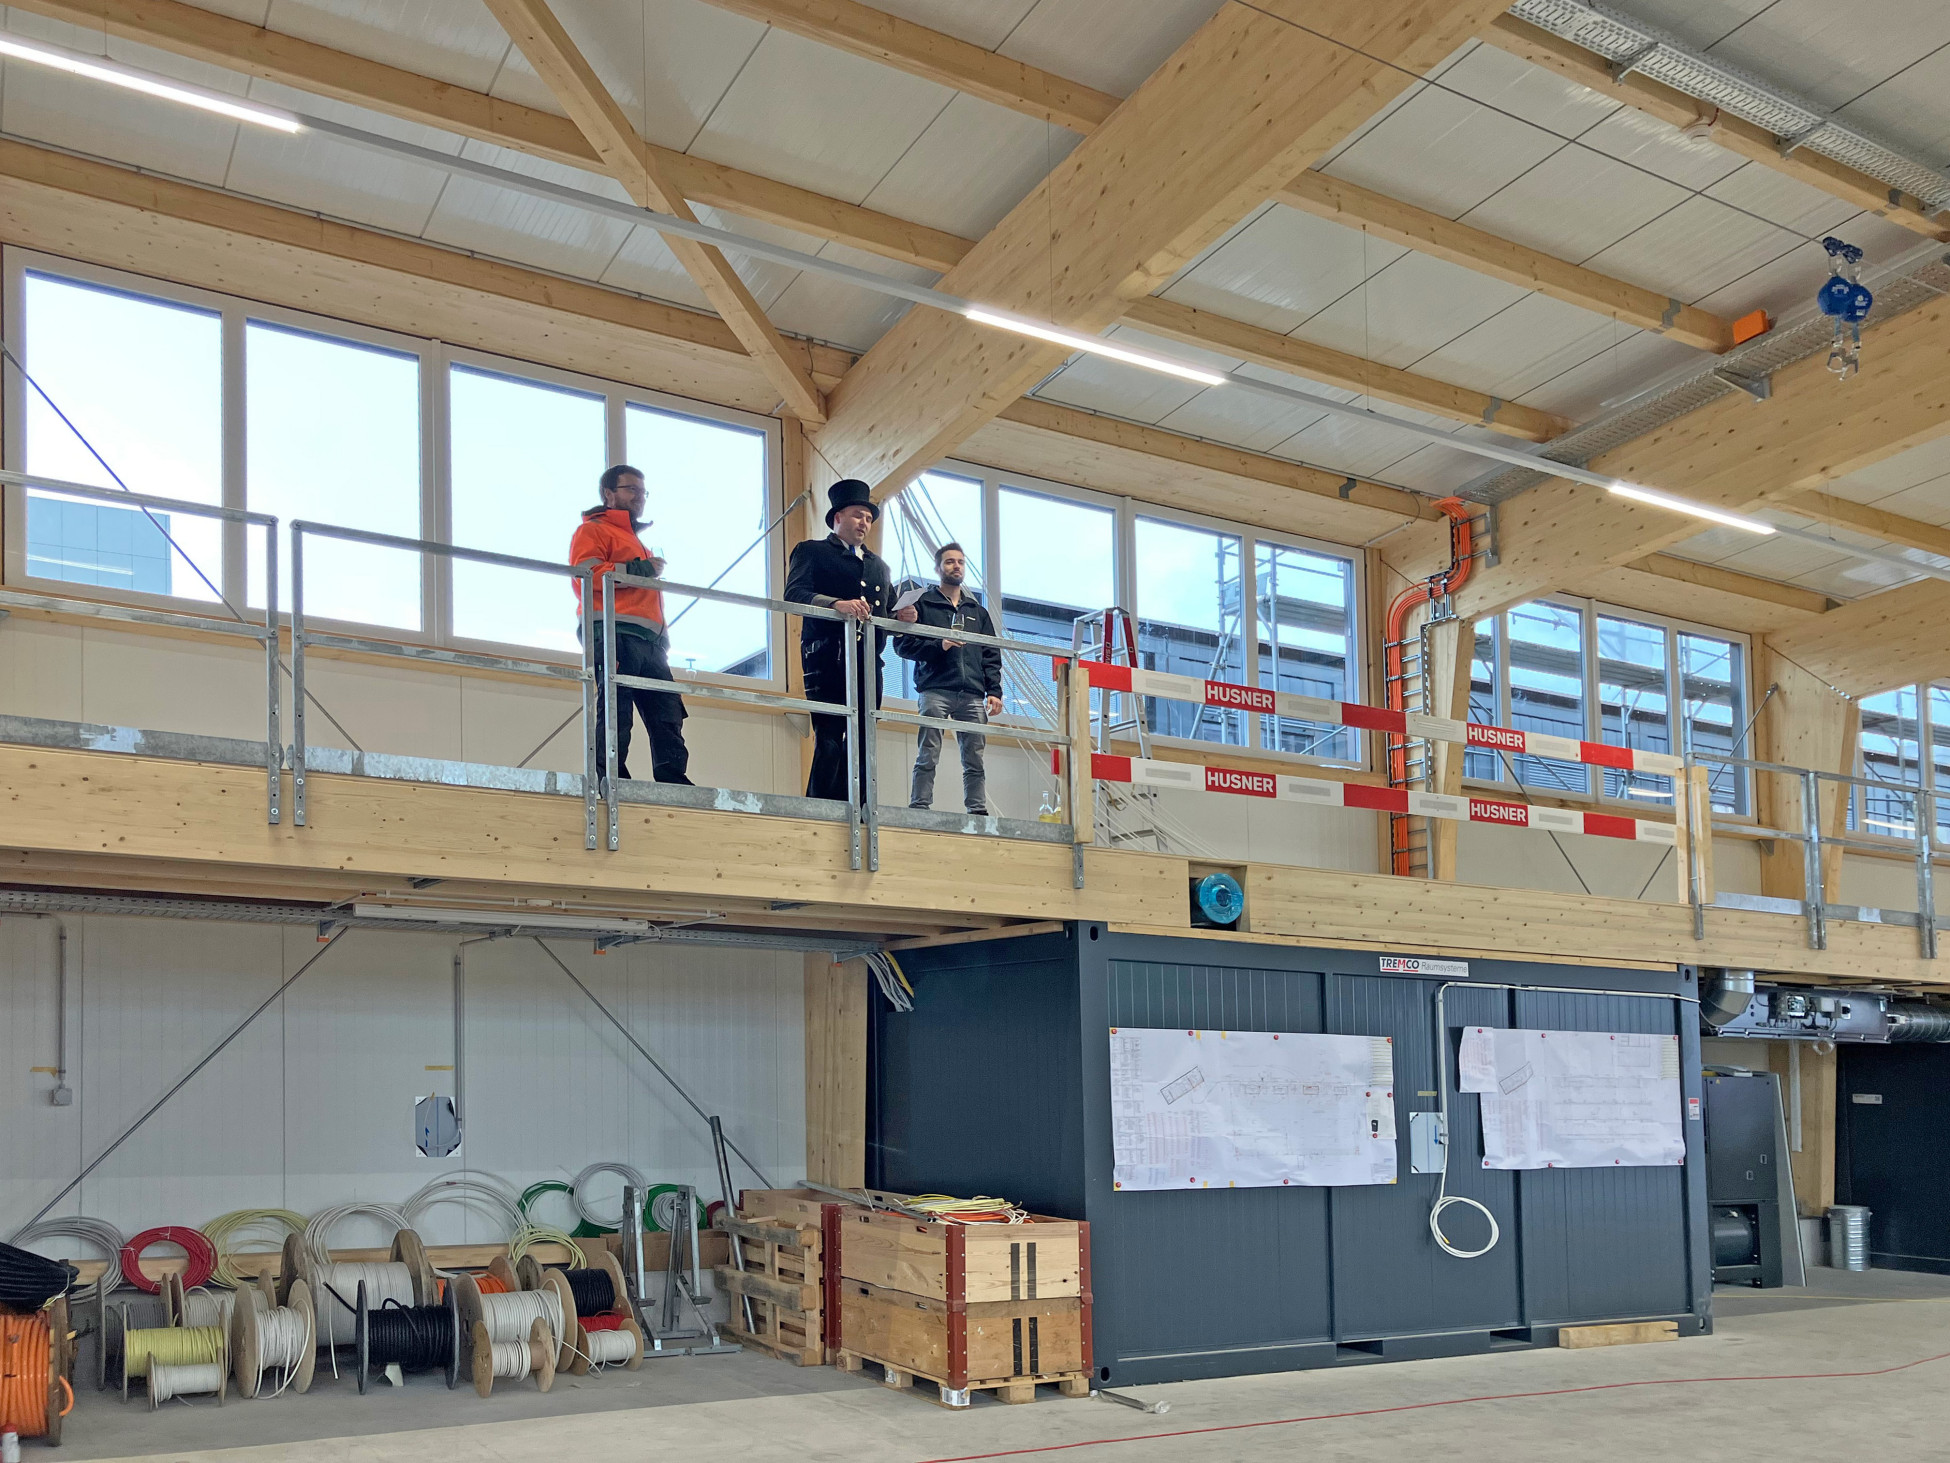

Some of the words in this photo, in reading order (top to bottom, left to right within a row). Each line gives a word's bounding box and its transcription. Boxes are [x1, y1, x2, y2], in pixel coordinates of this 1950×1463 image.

[1207, 685, 1273, 709] HUSNER
[1468, 726, 1524, 748] HUSNER
[1207, 771, 1274, 793] HUSNER
[1471, 802, 1526, 822] HUSNER
[1381, 958, 1420, 969] TREMCO
[1421, 962, 1468, 974] Raumsysteme
